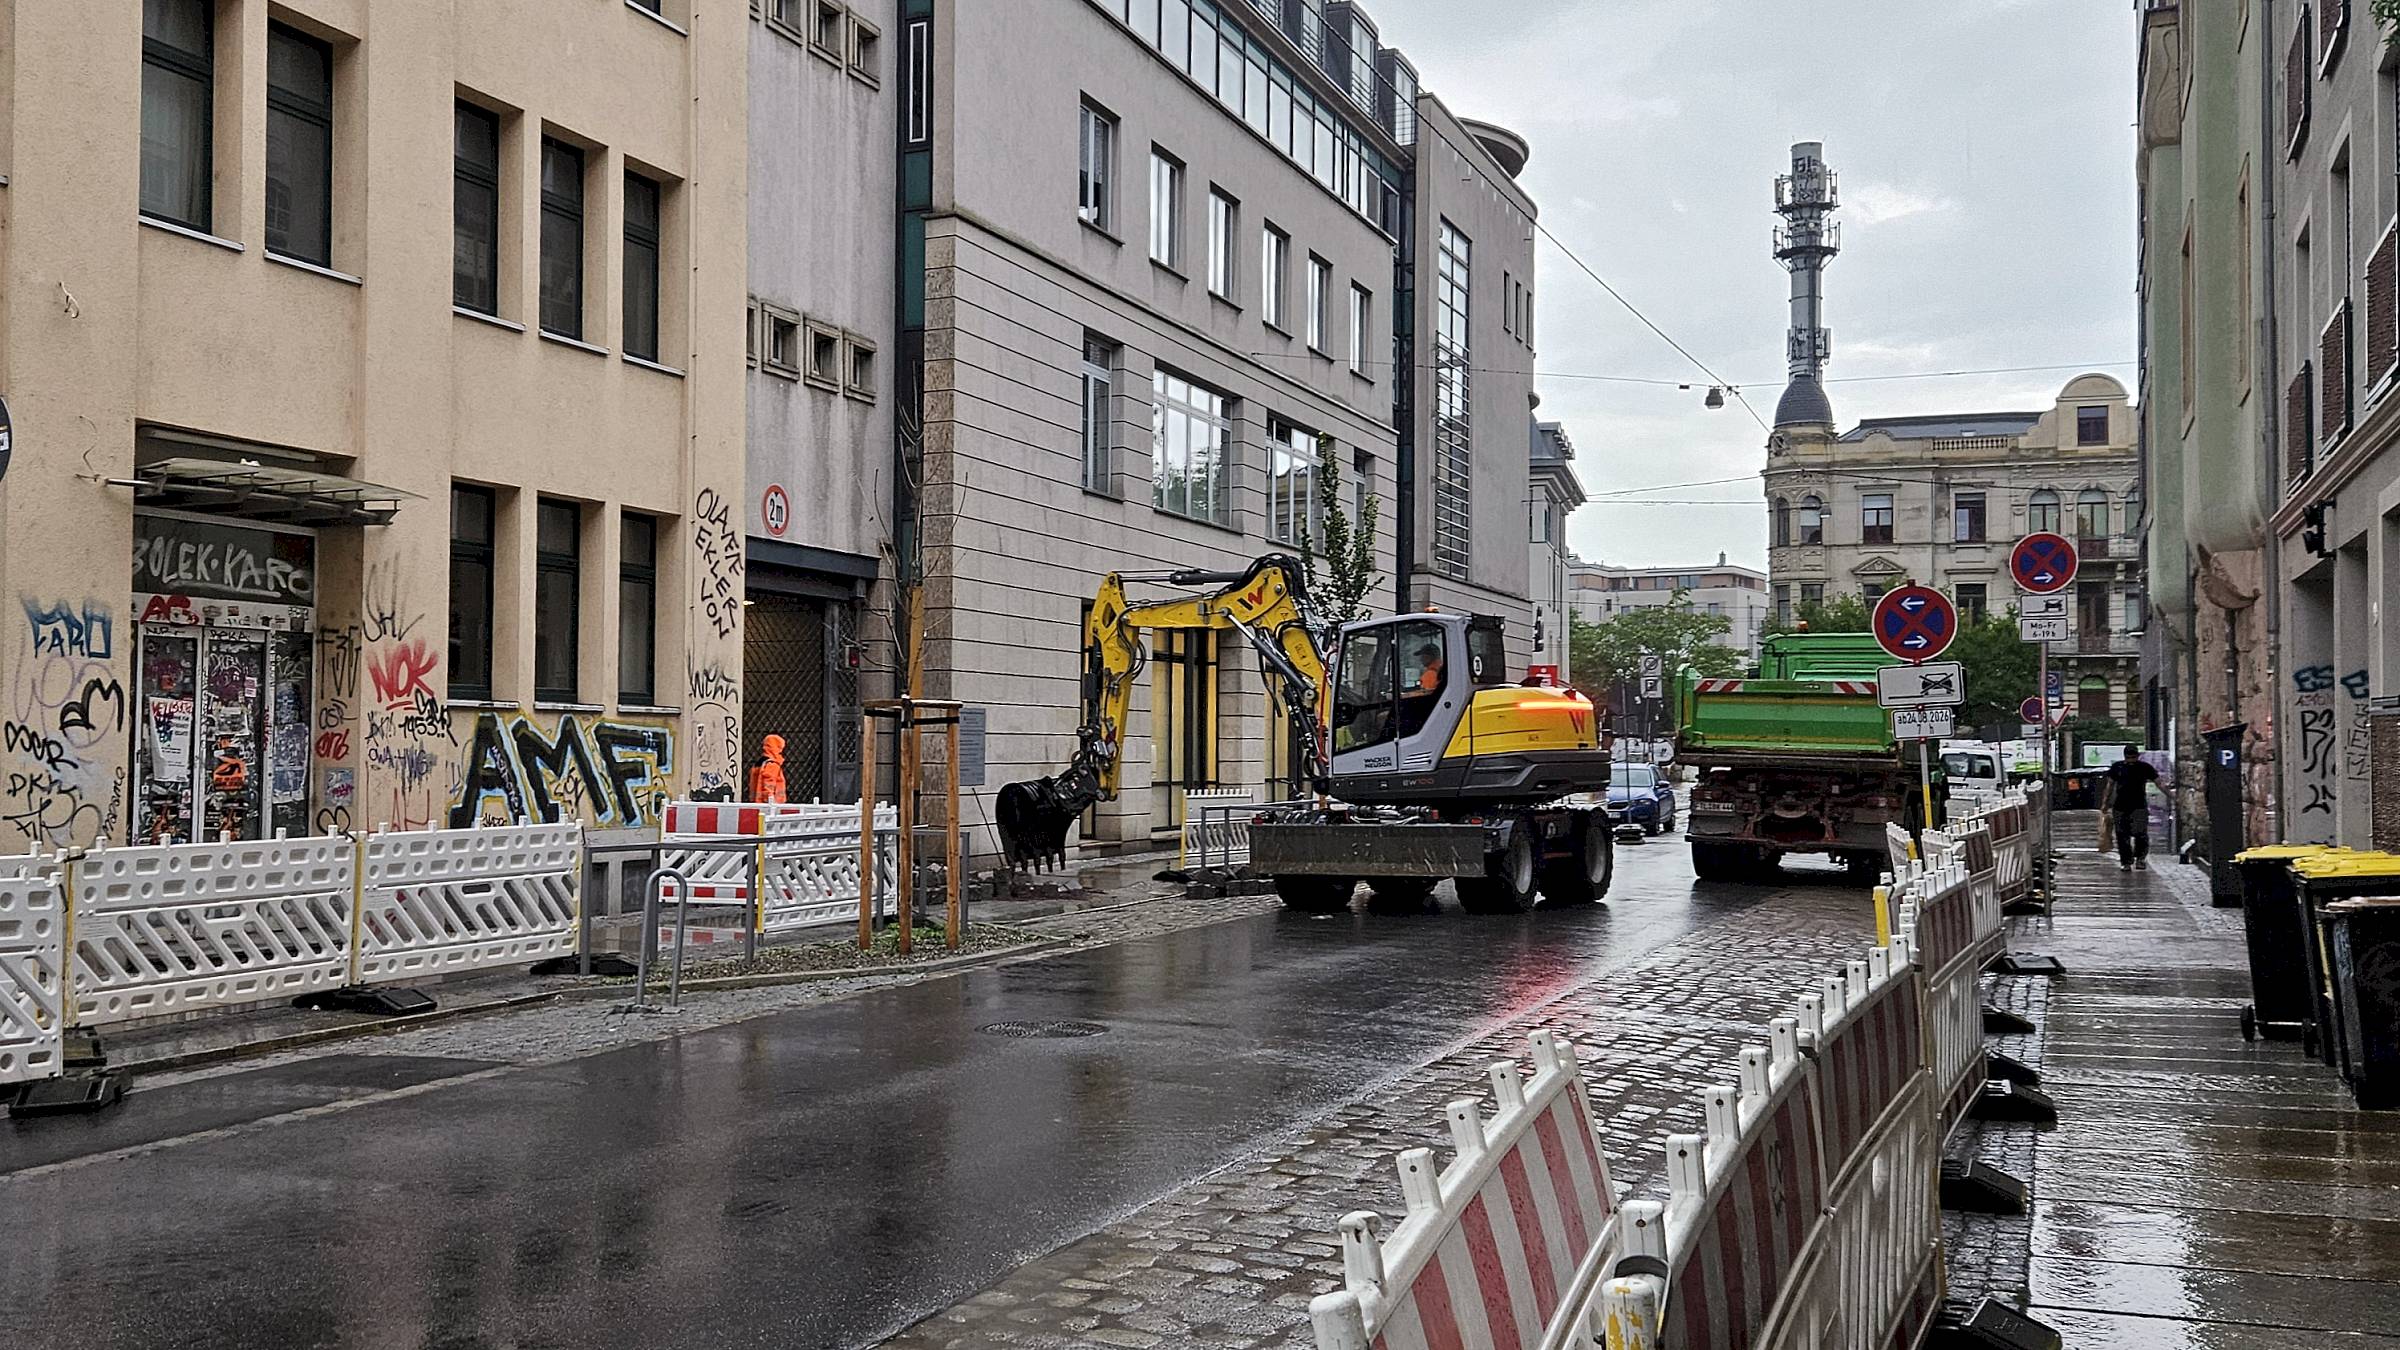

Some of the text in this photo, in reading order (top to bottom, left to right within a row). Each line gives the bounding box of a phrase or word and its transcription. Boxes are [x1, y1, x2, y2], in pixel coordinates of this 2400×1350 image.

[2030, 621, 2057, 630] Mo-Fr
[367, 638, 439, 703] NOK
[2221, 749, 2235, 766] P
